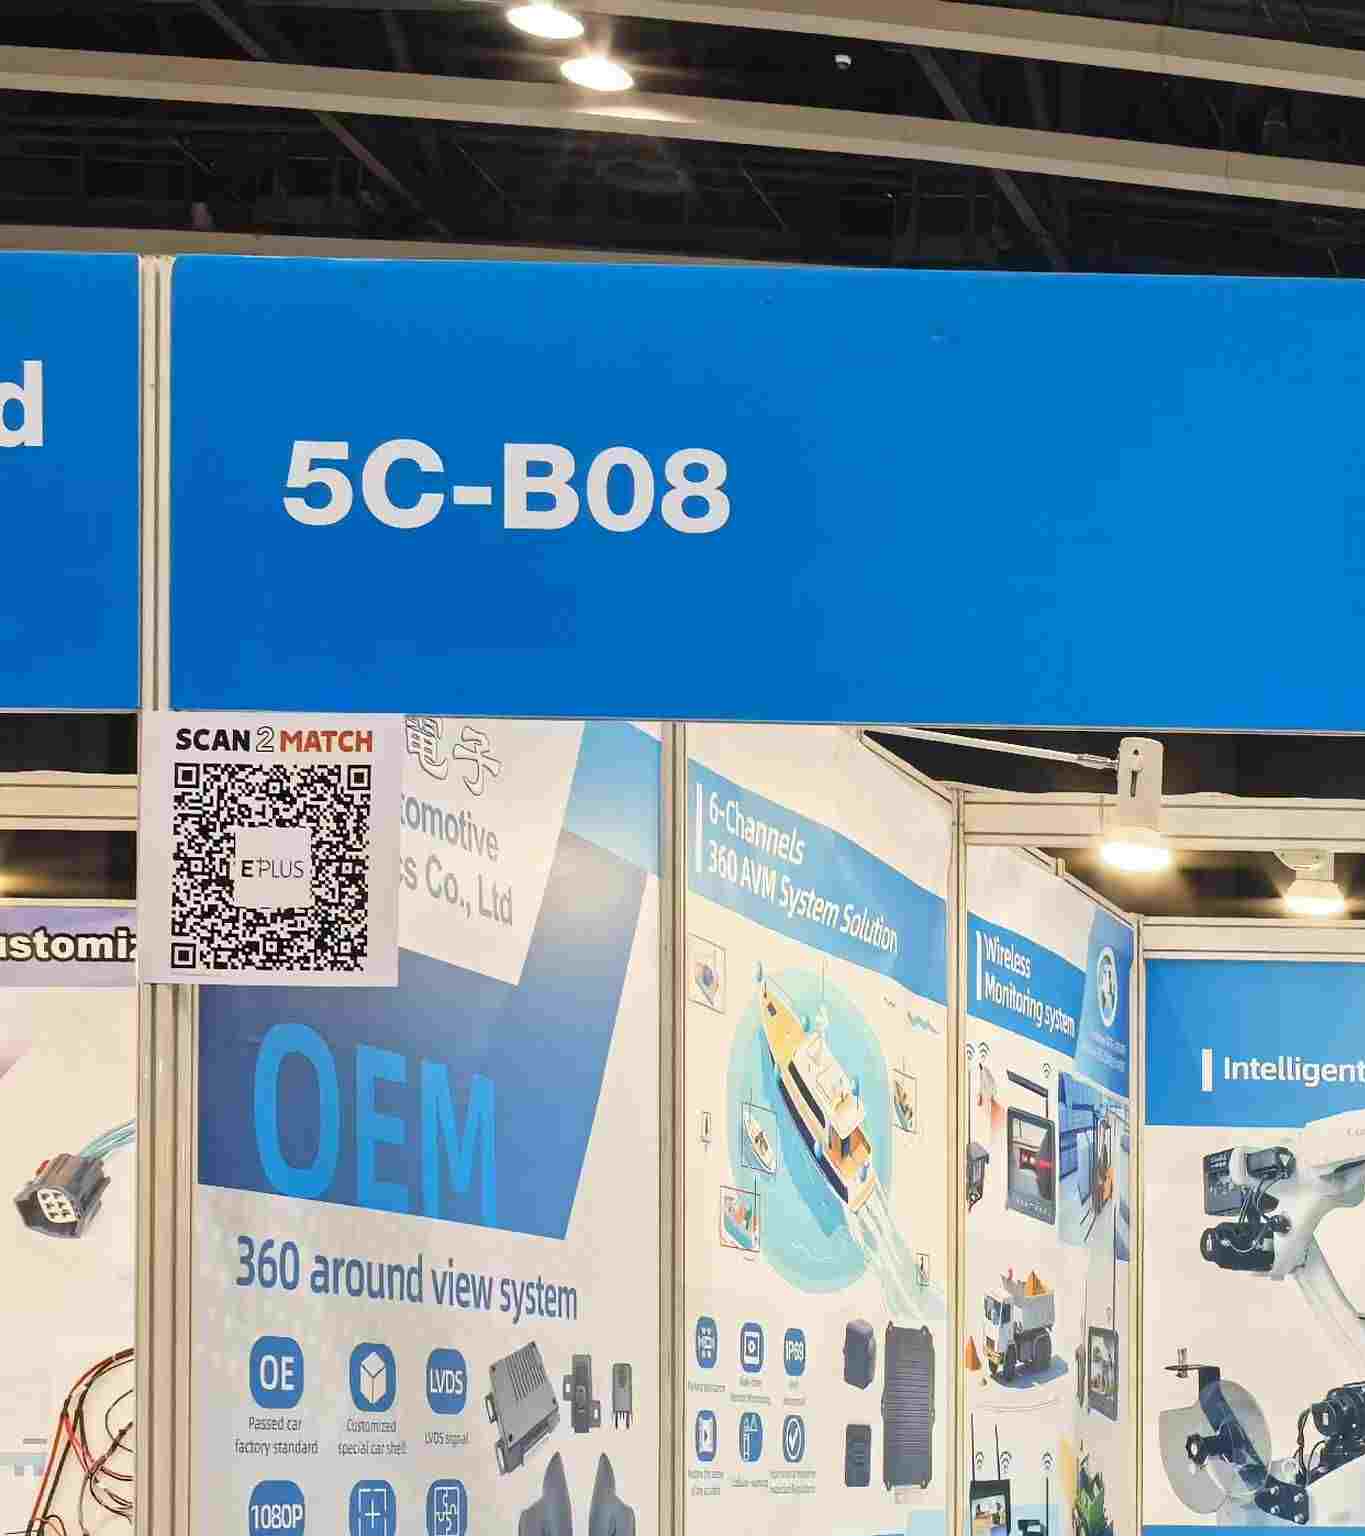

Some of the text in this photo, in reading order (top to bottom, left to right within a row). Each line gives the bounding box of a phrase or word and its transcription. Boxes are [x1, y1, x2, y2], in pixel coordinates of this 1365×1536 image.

[283, 438, 731, 534] 5C-B08
[708, 791, 806, 865] 6-Channels
[425, 852, 472, 919] Co.,
[478, 872, 514, 928] Ltd
[707, 840, 898, 952] 360 AVM System Solution
[984, 931, 1032, 979] Wireless
[984, 971, 1075, 1038] Monitoring system
[253, 1022, 498, 1227] OEM
[236, 1235, 577, 1325] 360 around view system
[259, 1355, 295, 1391] OE
[429, 1367, 464, 1397] LVDS
[250, 1504, 304, 1529] 1080P
